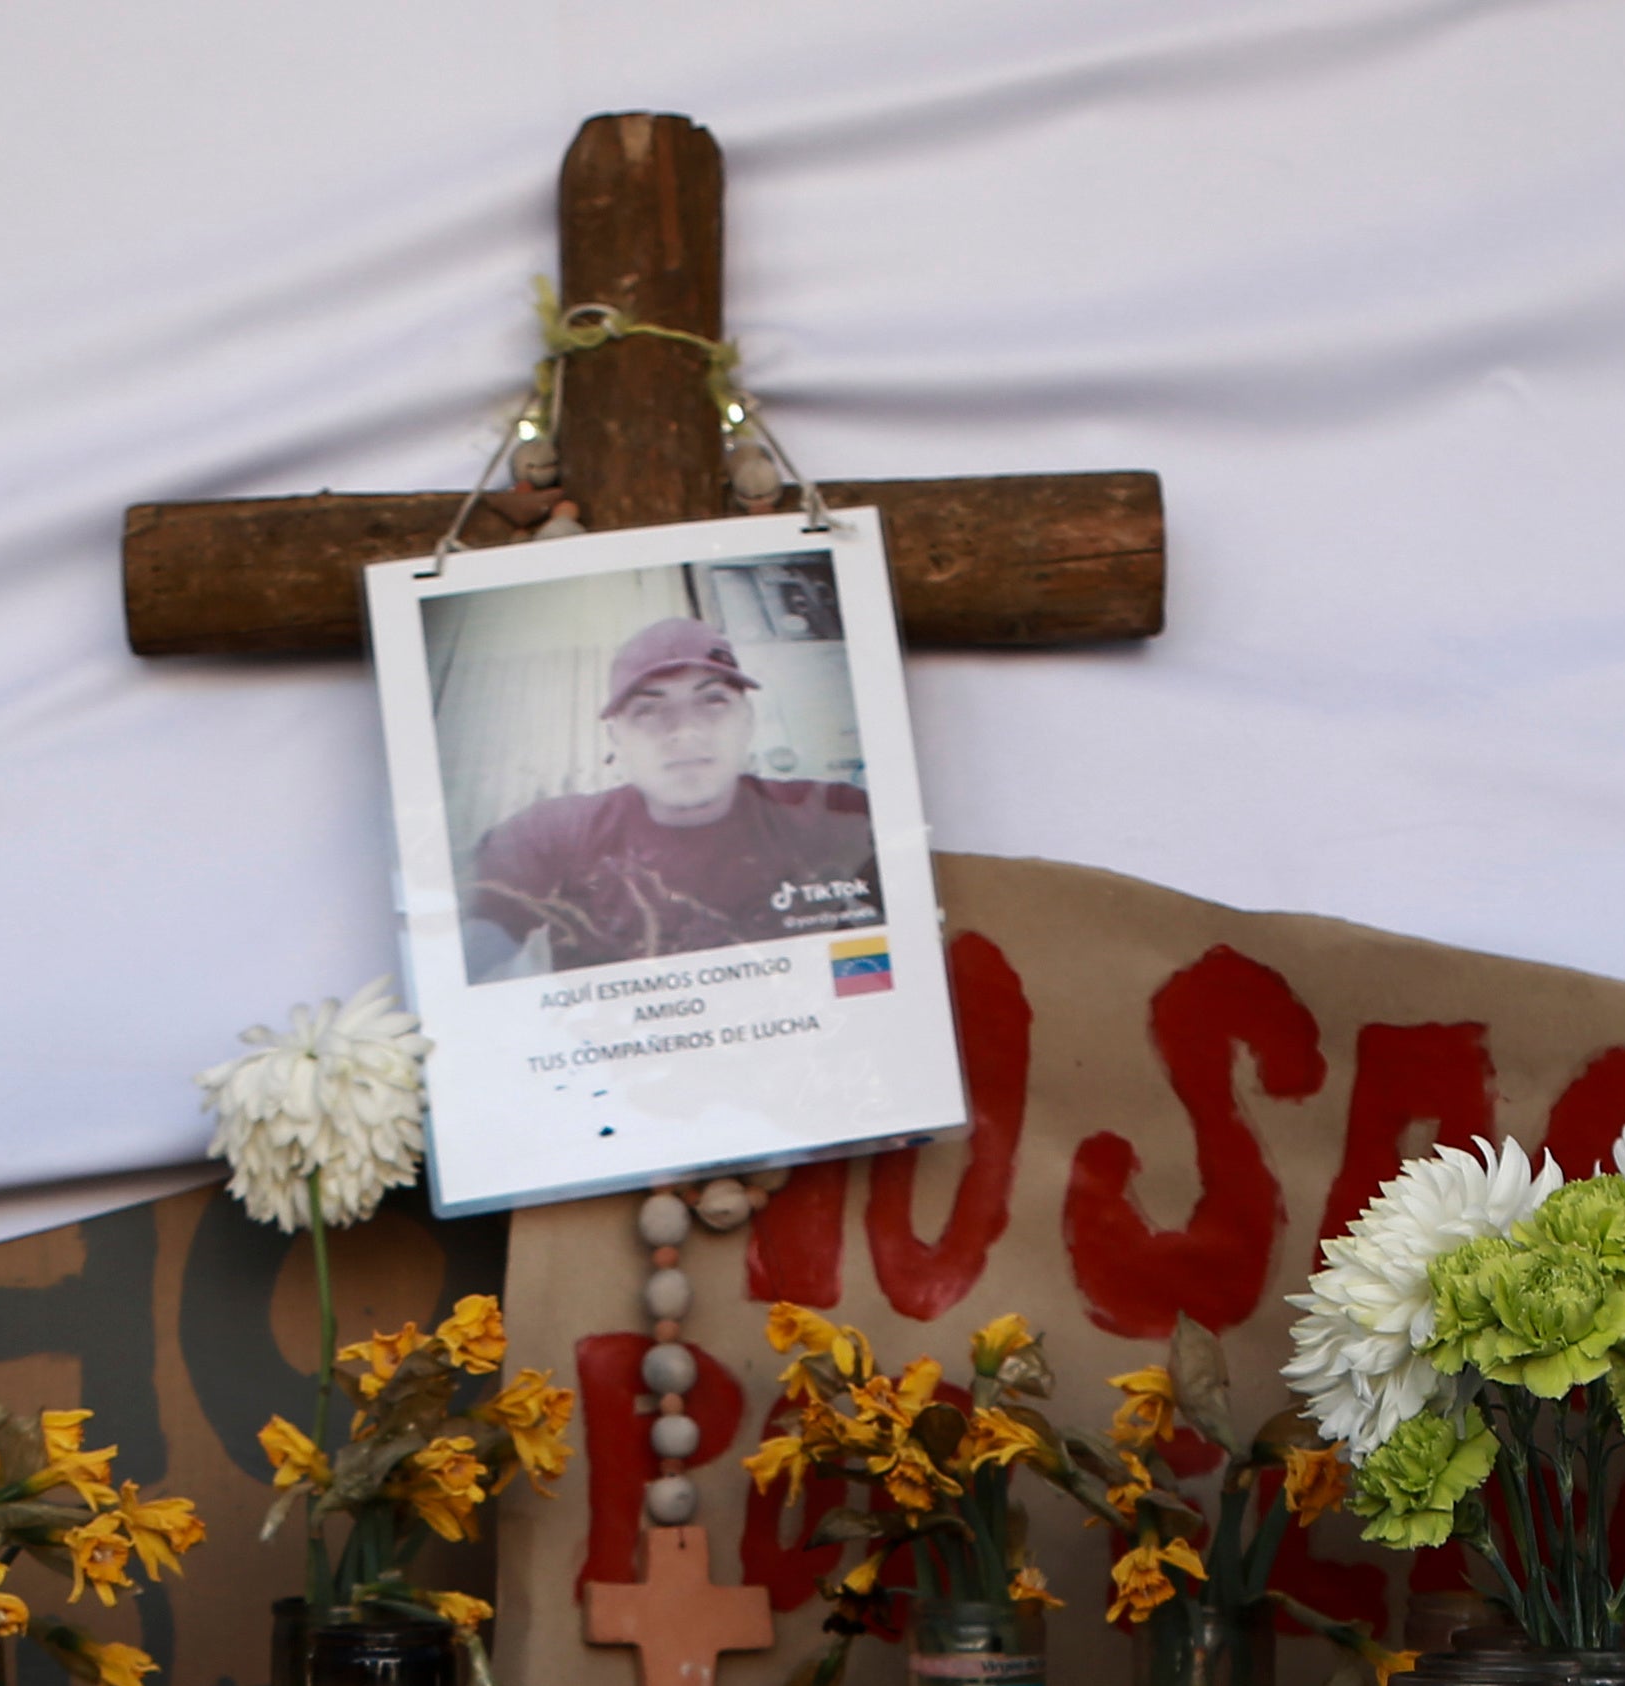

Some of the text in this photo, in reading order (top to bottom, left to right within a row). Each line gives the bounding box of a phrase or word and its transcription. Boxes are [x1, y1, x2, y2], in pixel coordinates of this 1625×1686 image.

[800, 878, 872, 903] TikTok
[539, 956, 792, 1009] AQUÍ ESTAMOS CONTIGO
[633, 997, 706, 1024] AMIGO
[527, 1014, 820, 1073] TUS COMPAÑEROS DE LUCHA
